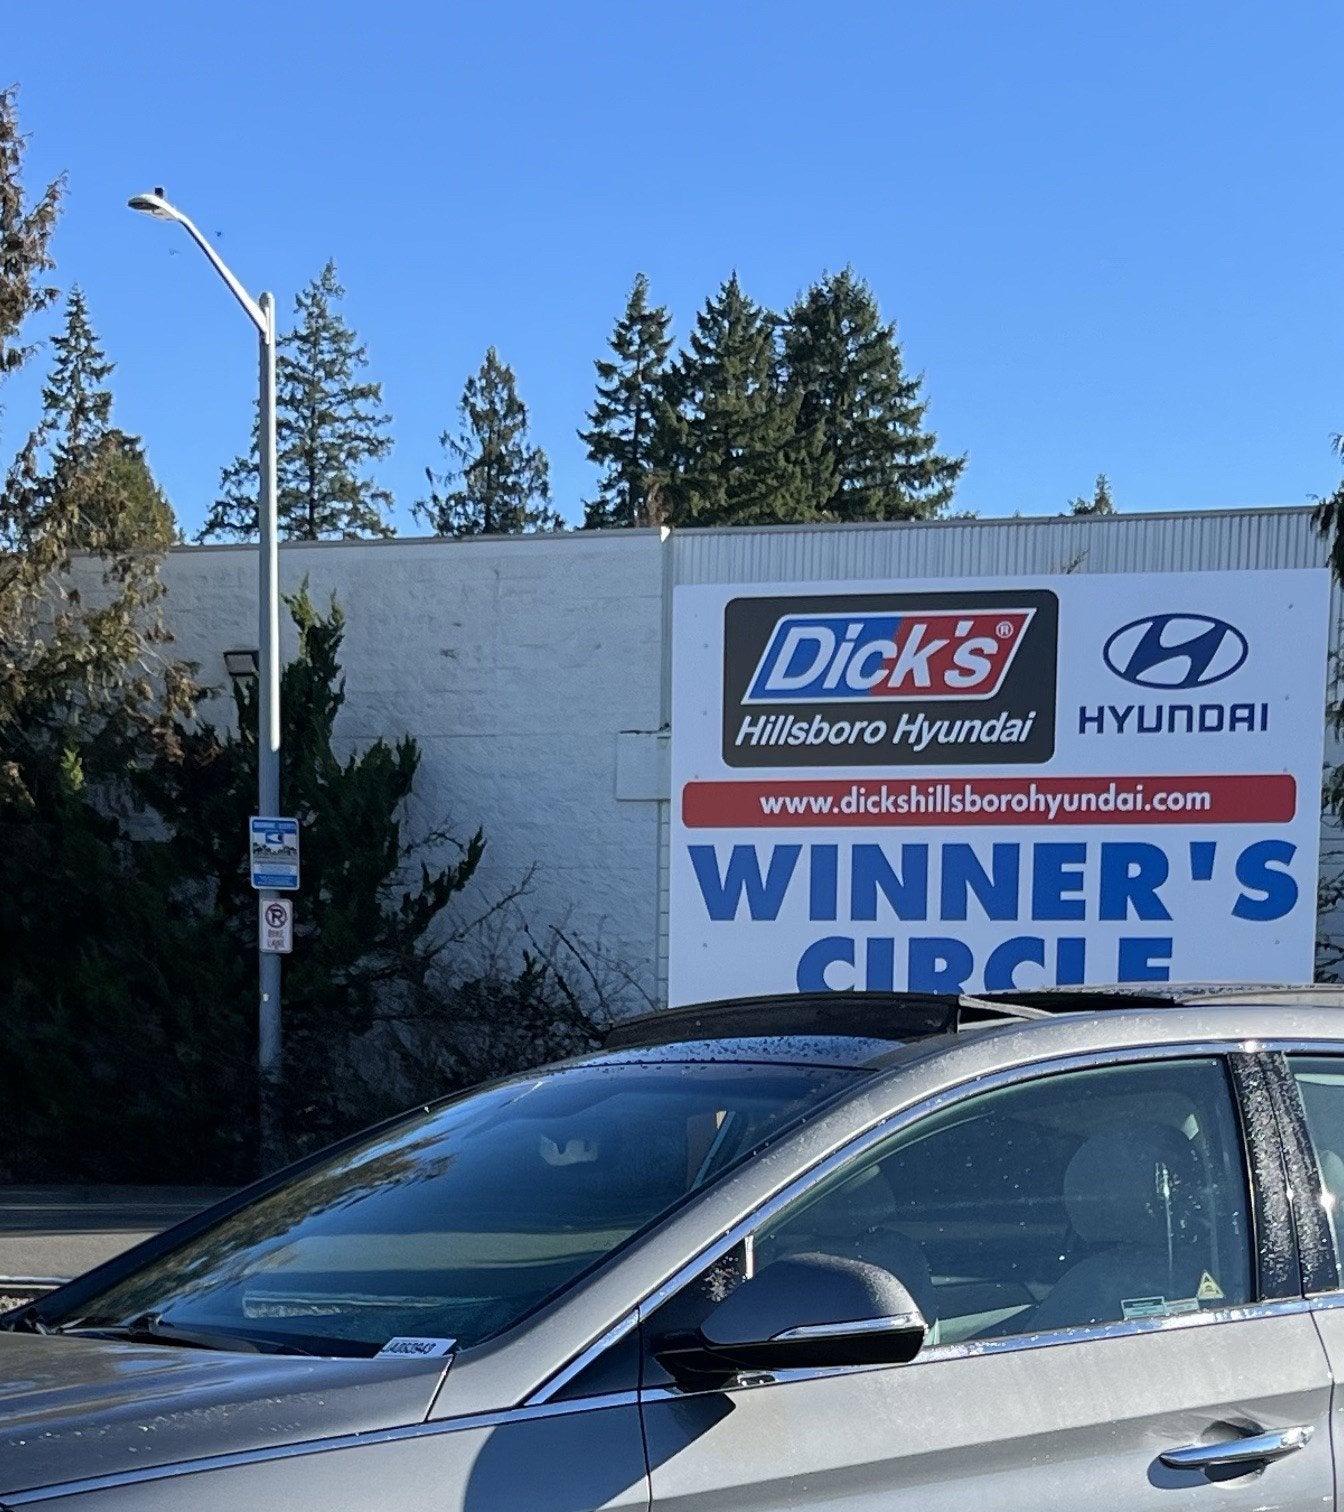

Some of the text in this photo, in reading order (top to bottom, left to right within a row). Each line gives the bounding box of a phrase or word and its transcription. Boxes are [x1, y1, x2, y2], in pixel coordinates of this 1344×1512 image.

[764, 620, 999, 691] Dick's
[735, 710, 1038, 752] Hillsboro Hyundai
[1079, 702, 1268, 735] HYUNDAI
[759, 783, 1211, 820] www.dickshillsborohyundai.com
[688, 839, 1299, 922] WINNER'S
